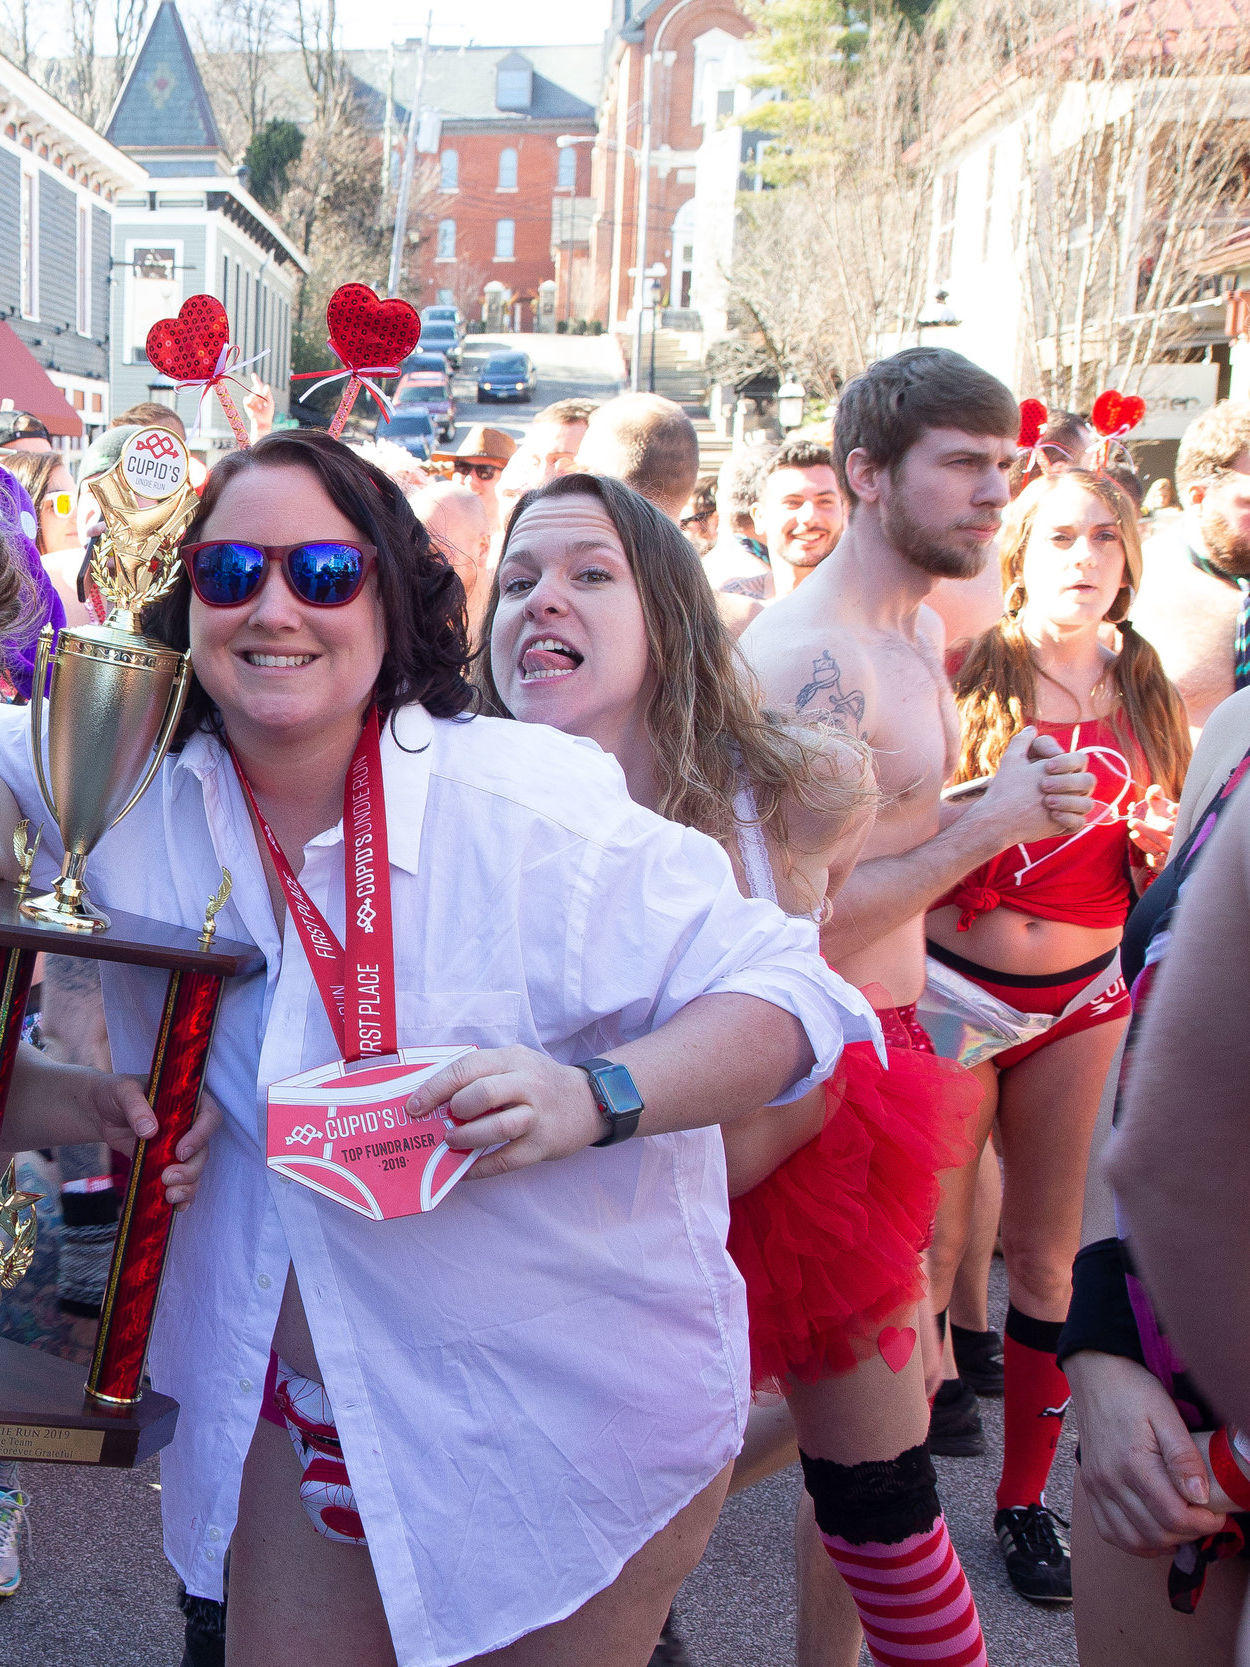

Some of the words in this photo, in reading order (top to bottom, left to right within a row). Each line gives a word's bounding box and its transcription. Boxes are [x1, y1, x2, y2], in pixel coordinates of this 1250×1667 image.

[127, 456, 180, 482] CUPID'S
[135, 477, 153, 489] UNDIE
[153, 481, 166, 490] RUN
[352, 755, 371, 787] RUN
[352, 787, 374, 834] UNDIE
[355, 833, 376, 898] CUPID'S
[301, 916, 337, 959] FIRST
[356, 963, 381, 1016] PLACE
[358, 1019, 382, 1060] IRST
[324, 1107, 396, 1141] CUPID'S
[341, 1147, 364, 1164] TOP
[364, 1133, 437, 1159] FUNDRAISER
[9, 1438, 33, 1447] Team
[15, 1427, 41, 1439] RUN
[43, 1429, 71, 1440] 2019
[34, 1448, 74, 1459] Grateful
